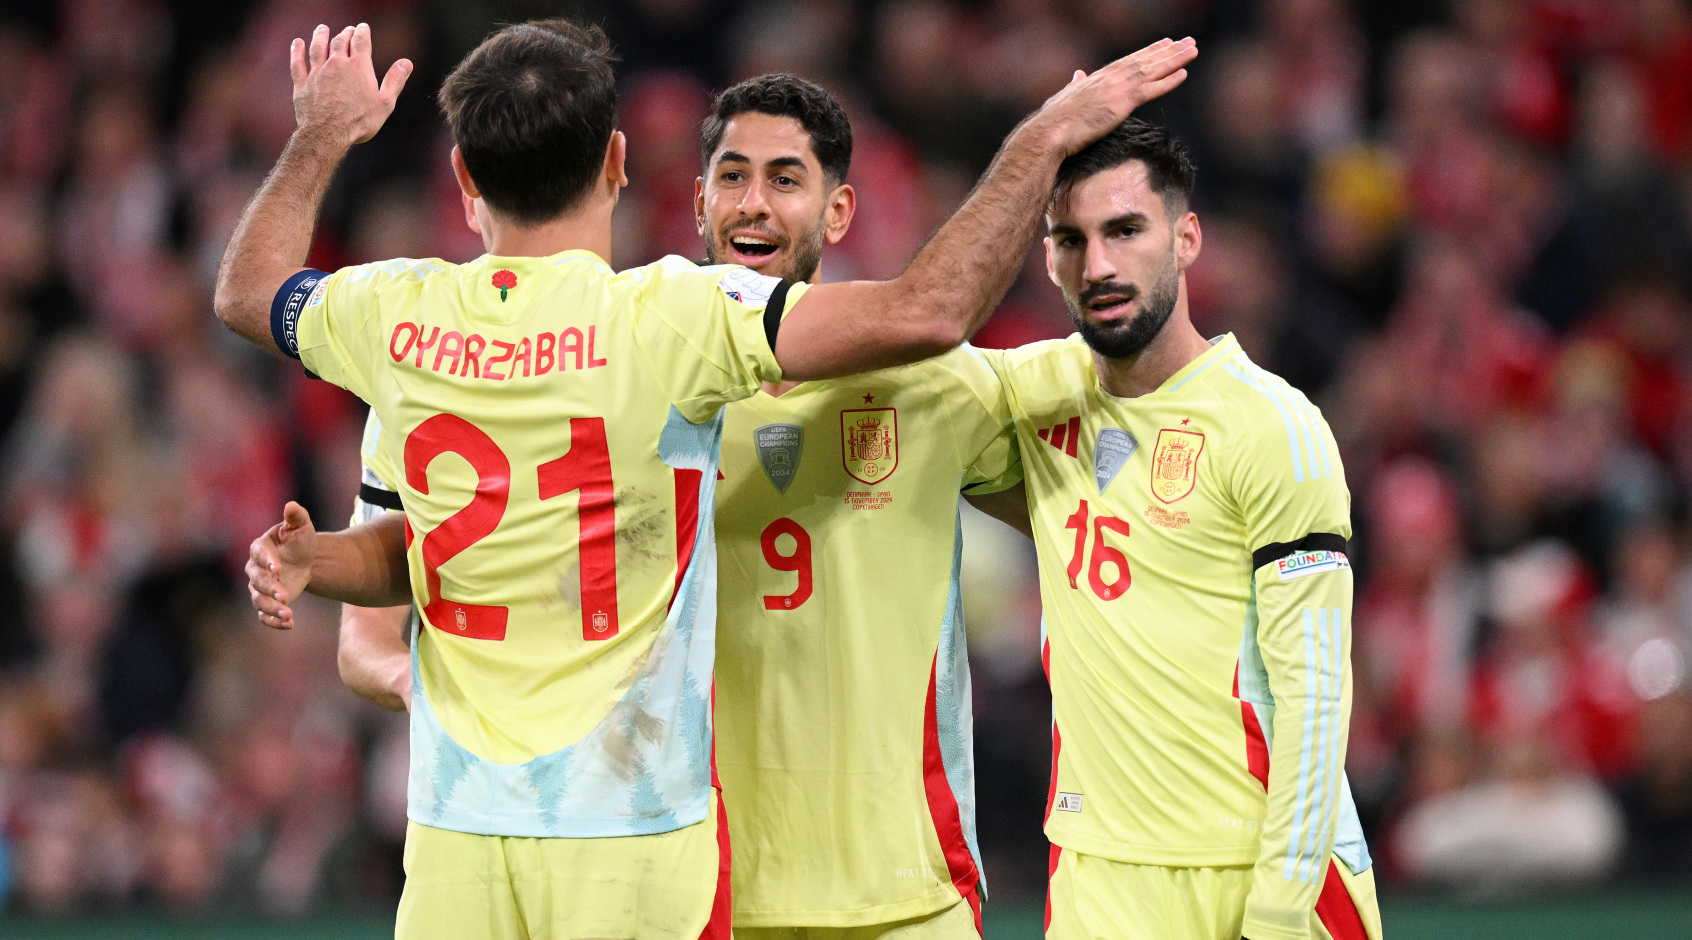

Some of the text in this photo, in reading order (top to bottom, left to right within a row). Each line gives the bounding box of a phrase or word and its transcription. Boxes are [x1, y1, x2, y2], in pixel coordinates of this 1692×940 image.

[389, 321, 607, 381] OYARZABAL
[759, 433, 799, 441] EUROPEAN
[759, 440, 799, 448] CHAMPIONS
[1100, 434, 1133, 449] EUROPEAN
[1098, 441, 1130, 455] CHAMPIONS
[771, 469, 790, 477] 2024
[1096, 470, 1111, 479] 2024
[852, 503, 885, 511] COPENHAGEN
[404, 413, 620, 642] 21
[1064, 499, 1132, 601] 16
[760, 517, 813, 611] 9
